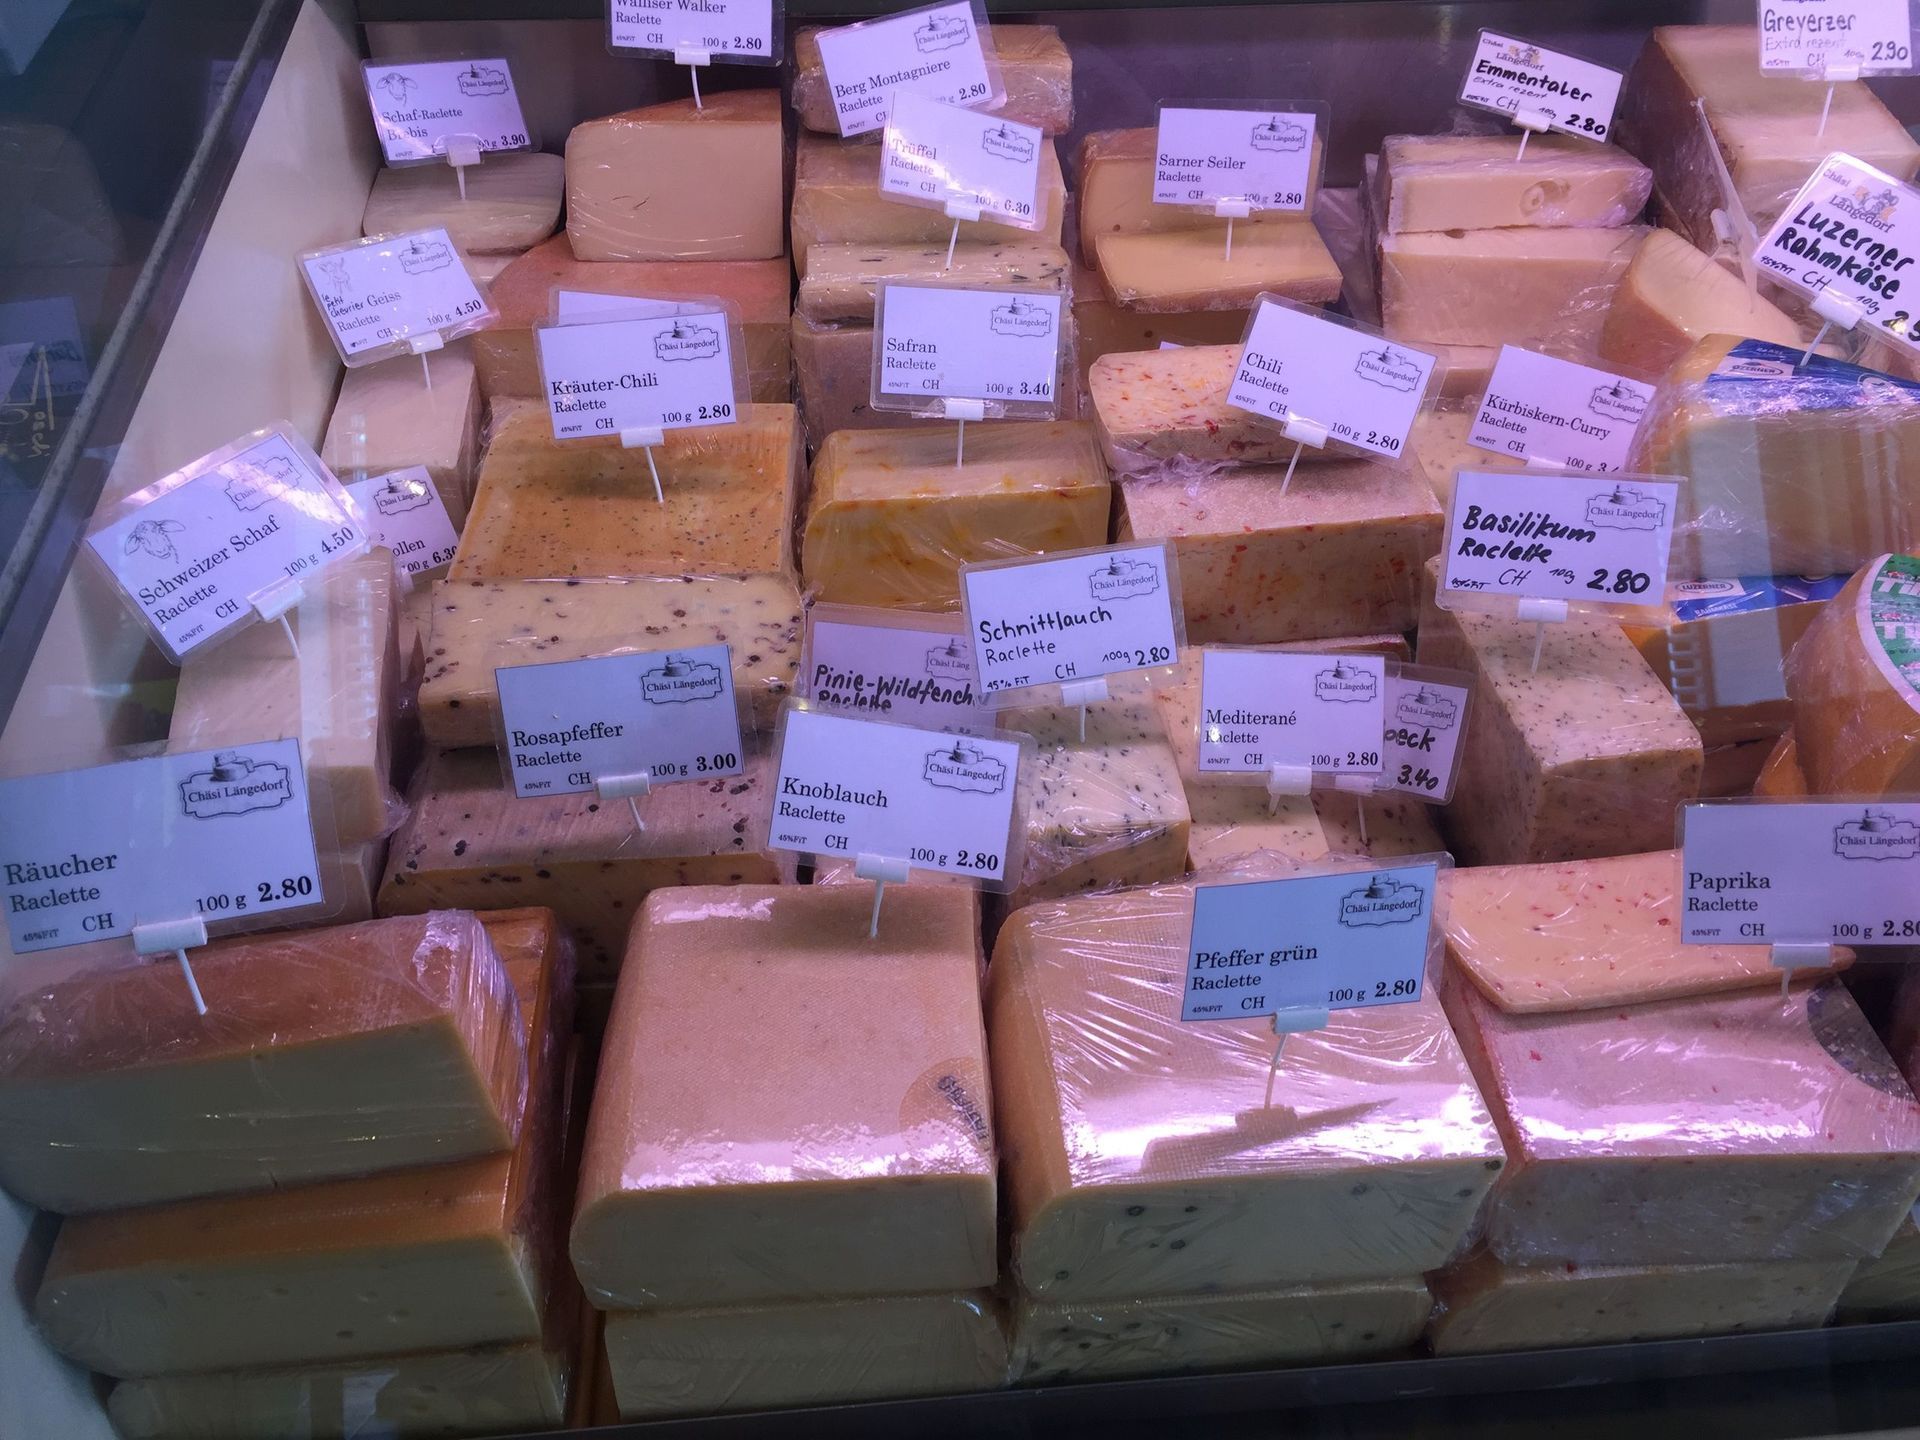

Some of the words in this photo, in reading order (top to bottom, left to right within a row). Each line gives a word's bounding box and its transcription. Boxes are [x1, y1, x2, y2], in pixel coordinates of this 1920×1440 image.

[616, 12, 661, 24] Raclette
[678, 0, 726, 13] Walker
[1764, 9, 1856, 39] Greyerzer
[647, 34, 663, 43] CH
[702, 38, 719, 47] 100
[722, 39, 727, 48] g
[734, 37, 761, 49] 2.80
[1871, 41, 1908, 60] 2.90
[835, 81, 865, 98] Berg
[869, 59, 950, 89] Montagniere
[1474, 76, 1504, 88] Extra
[1509, 85, 1547, 99] rezent
[1476, 59, 1592, 102] Emmentaler
[959, 82, 986, 101] 2.80
[383, 108, 463, 122] Schaf-Raclette
[840, 95, 883, 114] Raclette
[1496, 96, 1520, 111] CH
[1565, 114, 1606, 135] 2.80
[501, 134, 525, 145] 3.90
[892, 138, 936, 160] Trüffel
[890, 156, 933, 175] Raclette
[1159, 154, 1204, 167] Sarner
[1208, 156, 1245, 169] Seiler
[1158, 171, 1201, 182] Raclette
[920, 181, 936, 193] CH
[975, 195, 991, 205] 100
[1004, 200, 1030, 215] 6.30
[1188, 190, 1203, 199] CH
[1244, 193, 1259, 201] 100
[1274, 192, 1301, 204] 2.80
[1793, 202, 1915, 271] Luzerner
[1774, 227, 1900, 299] Rahmkäse
[367, 291, 401, 307] Geiss
[1803, 271, 1832, 292] CH
[1857, 295, 1879, 315] 100g
[336, 314, 380, 332] Raclette
[377, 327, 392, 339] CH
[428, 314, 443, 326] 100
[455, 299, 482, 317] 4.50
[887, 338, 936, 353] Safran
[887, 357, 936, 370] Raclette
[1247, 352, 1283, 375] Chili
[552, 373, 659, 395] Kräuter-Chili
[923, 379, 940, 389] CH
[986, 383, 1003, 393] 100
[1007, 386, 1013, 394] g
[1020, 382, 1050, 396] 3.40
[1239, 370, 1289, 396] Raclette
[554, 399, 606, 413] Raclette
[595, 418, 614, 429] CH
[662, 412, 681, 423] 100
[685, 412, 692, 423] g
[698, 404, 731, 420] 2.80
[1486, 394, 1610, 441] Kürbiskern-Curry
[1269, 401, 1287, 414] CH
[1332, 422, 1351, 436] 100
[1353, 430, 1360, 441] g
[1366, 431, 1399, 450] 2.80
[1480, 412, 1527, 434] Raclette
[1508, 440, 1525, 453] CH
[1566, 457, 1583, 469] 100
[1463, 505, 1596, 543] Basilikum
[138, 547, 230, 606] Schweizer
[229, 514, 280, 553] Schaf
[215, 599, 239, 619] CH
[284, 558, 308, 577] 100
[309, 553, 319, 565] g
[320, 524, 353, 555] 4.50
[423, 560, 429, 568] g
[1499, 569, 1531, 586] CH
[1549, 568, 1575, 584] 100g
[1587, 569, 1650, 593] 2.80
[153, 583, 218, 625] Raclette
[980, 606, 1112, 643] Schnittlauch
[986, 641, 1056, 665] Raclette
[1055, 662, 1076, 679] CH
[1102, 650, 1130, 664] 100g
[1135, 647, 1169, 665] 2.80
[647, 681, 671, 692] Chäsi
[674, 677, 717, 689] Längedorf
[1206, 709, 1296, 726] Mediterané
[512, 722, 623, 747] Rosapfeffer
[515, 752, 582, 767] Raclette
[568, 772, 592, 786] CH
[651, 763, 675, 776] 100
[680, 763, 688, 776] g
[696, 753, 737, 772] 3.00
[1244, 754, 1263, 764] CH
[1311, 754, 1330, 765] 100
[1333, 756, 1340, 767] g
[1347, 752, 1378, 766] 2.80
[930, 763, 954, 774] Chäsi
[956, 766, 1001, 781] Längedorf
[1398, 765, 1439, 790] 3.40
[189, 789, 221, 803] Chäsi
[225, 780, 285, 798] Längedorf
[782, 777, 888, 807] Knoblauch
[779, 801, 845, 824] Raclette
[1840, 835, 1866, 846] Chäsi
[1869, 836, 1916, 847] Längedorf
[824, 835, 848, 849] CH
[910, 848, 935, 862] 100
[938, 853, 947, 865] g
[956, 850, 998, 871] 2.80
[4, 853, 117, 885] Räucher
[1688, 872, 1771, 893] Paprika
[9, 887, 100, 913] Raclette
[82, 913, 114, 932] CH
[196, 894, 229, 913] 100
[236, 893, 247, 908] g
[258, 876, 312, 903] 2.80
[1346, 903, 1370, 913] Chäsi
[1373, 899, 1417, 912] Längedorf
[1688, 897, 1758, 911] Raclette
[1740, 924, 1765, 936] CH
[1832, 924, 1858, 936] 100
[1863, 926, 1872, 938] g
[1194, 950, 1264, 969] Pfeffer
[1270, 946, 1318, 966] grün
[1192, 975, 1261, 991] Raclette
[1241, 997, 1264, 1011] CH
[1328, 989, 1352, 1002] 100
[1357, 990, 1365, 1002] g
[1375, 978, 1416, 998] 2.80
